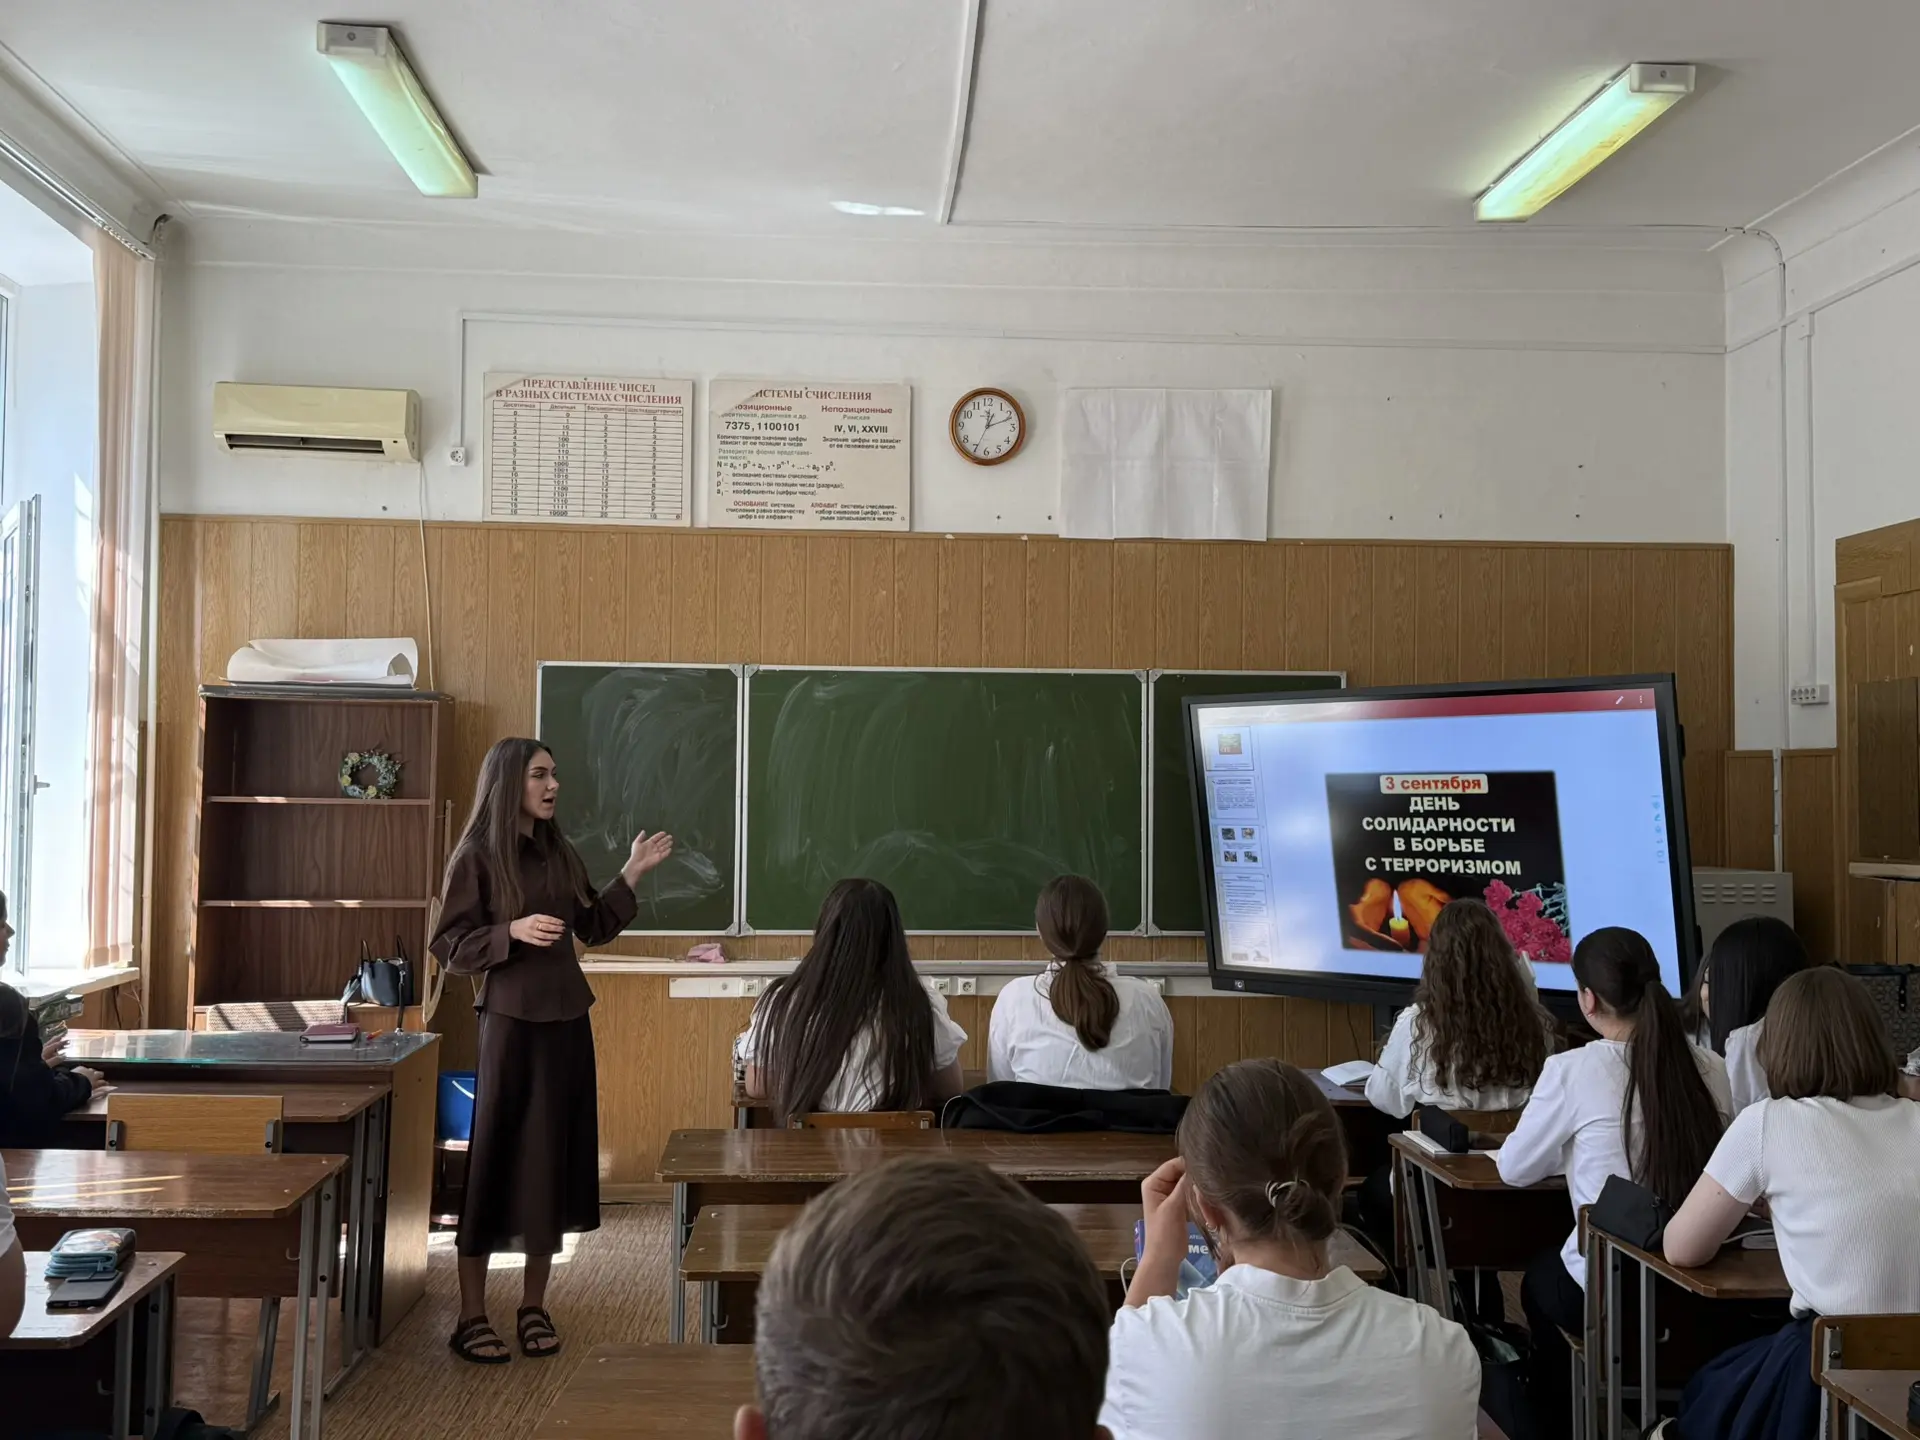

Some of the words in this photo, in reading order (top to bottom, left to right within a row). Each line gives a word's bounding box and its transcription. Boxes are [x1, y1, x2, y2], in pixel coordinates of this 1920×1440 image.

[522, 379, 617, 391] ПРЕДСТАВЛЕНИЕ
[619, 383, 656, 393] ЧИСЕЛ
[505, 390, 550, 399] РАЗНЫХ
[552, 391, 611, 401] СИСТЕМАХ
[614, 394, 682, 404] СЧИСЛЕНИЯ
[754, 389, 802, 398] ИСТЕМЫ
[805, 390, 872, 400] СЧИСЛЕНИЯ
[972, 402, 980, 410] 11
[983, 398, 993, 406] 12
[821, 405, 893, 414] Непозиционные
[963, 410, 972, 419] 10
[1006, 410, 1012, 420] 2
[725, 421, 754, 432] 7375,
[757, 422, 799, 431] 1100101
[834, 425, 846, 434] IV,
[848, 425, 859, 434] VI,
[958, 421, 964, 430] 9
[1009, 423, 1015, 432] 3
[963, 435, 968, 444] 8
[1004, 436, 1010, 444] 4
[973, 444, 979, 452] 7
[984, 447, 989, 456] 6
[996, 445, 1001, 453] 5
[1385, 776, 1395, 790] 3
[1400, 776, 1482, 793] сентября
[1409, 796, 1460, 813] ДЕНЬ
[1362, 817, 1516, 834] СОЛИДАРНОСТИ
[1393, 837, 1406, 851] В
[1411, 838, 1485, 853] БОРЬБЕ
[1365, 857, 1377, 871] С
[1381, 857, 1522, 875] ТЕРРОРИЗМОМ
